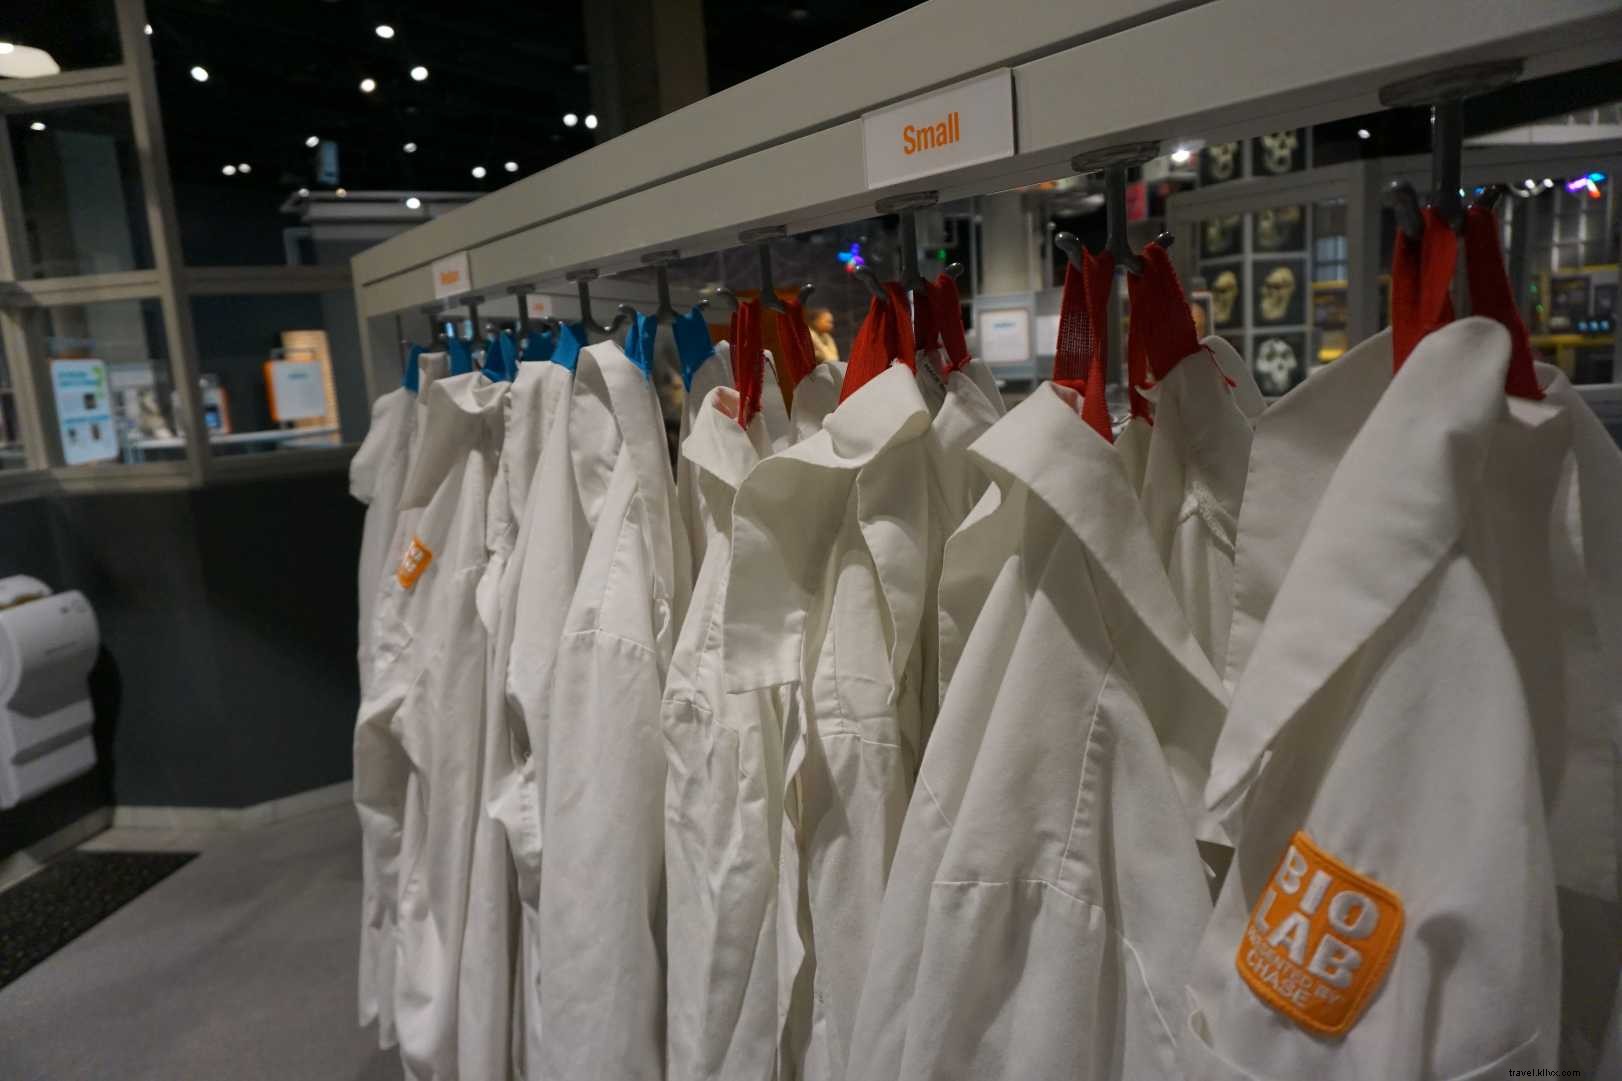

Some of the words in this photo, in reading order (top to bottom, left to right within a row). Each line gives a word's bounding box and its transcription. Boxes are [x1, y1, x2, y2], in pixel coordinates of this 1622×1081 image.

[903, 111, 960, 155] Small
[1275, 845, 1379, 939] BIO
[1255, 889, 1361, 988] LAB
[1247, 950, 1313, 1009] CHASE
